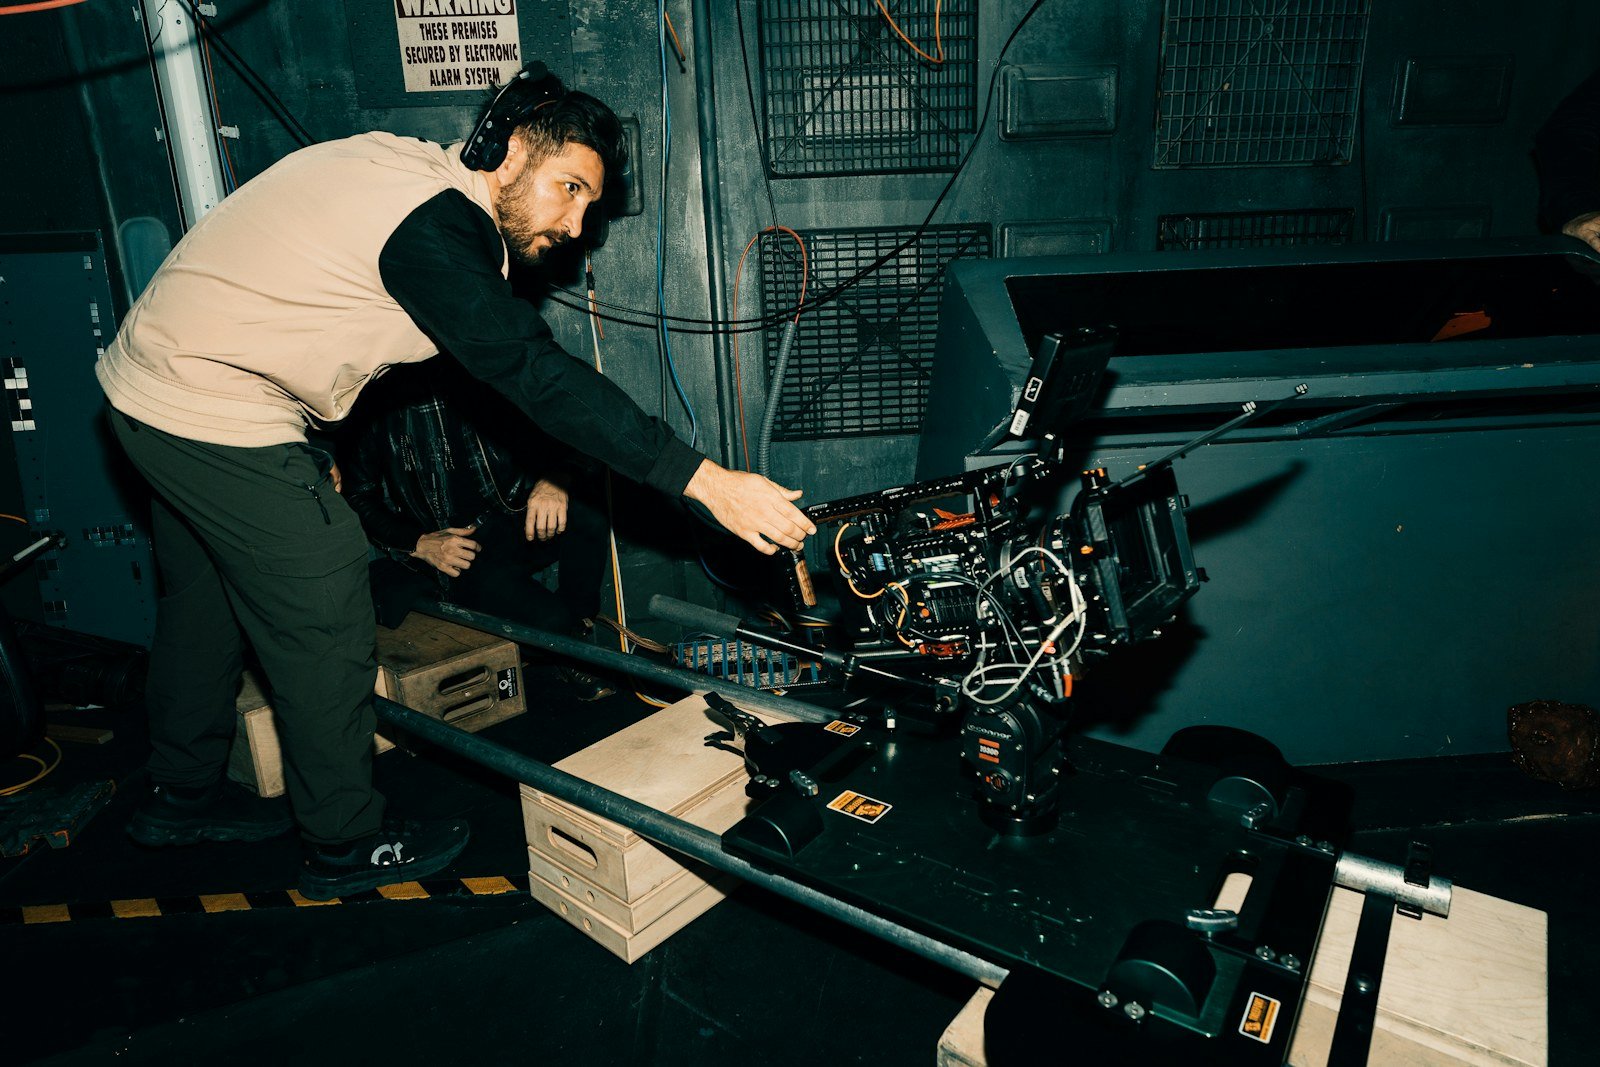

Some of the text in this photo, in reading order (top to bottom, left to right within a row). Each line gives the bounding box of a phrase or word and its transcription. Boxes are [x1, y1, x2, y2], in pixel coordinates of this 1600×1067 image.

[401, 0, 512, 16] WARNING
[419, 21, 498, 41] THESE PREMISES
[405, 43, 518, 64] SECURED BY ELECTRONIC
[430, 68, 501, 86] ALARM SYSTEM
